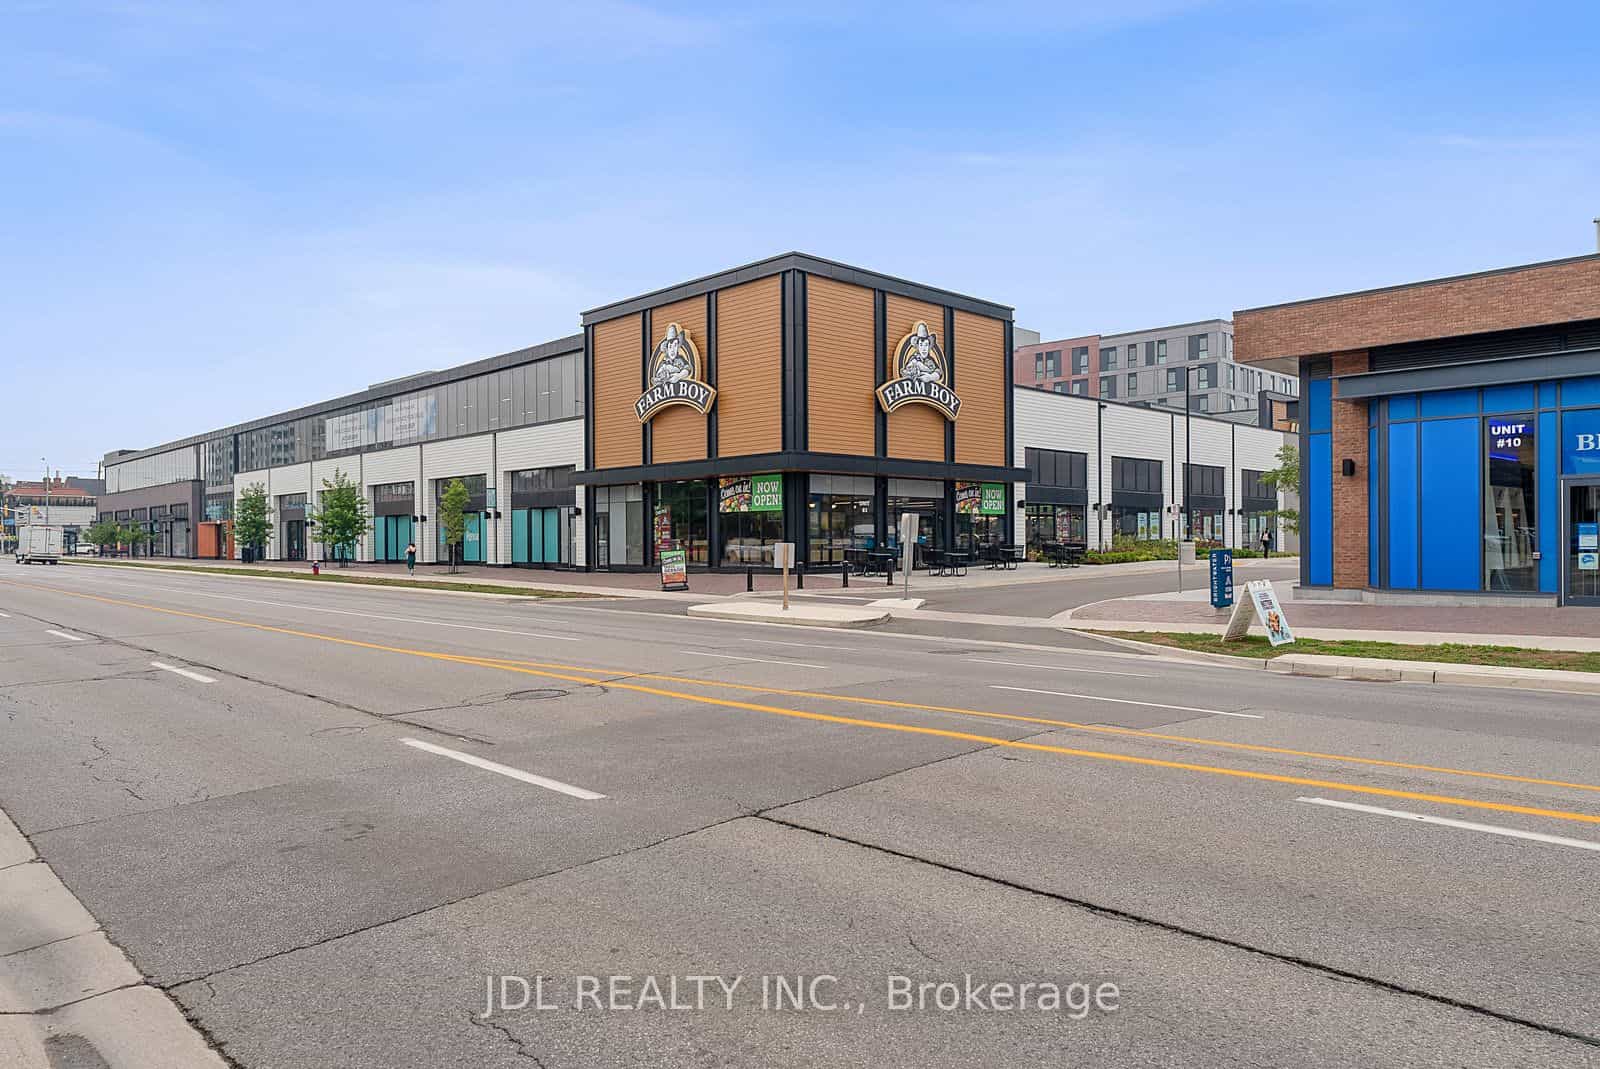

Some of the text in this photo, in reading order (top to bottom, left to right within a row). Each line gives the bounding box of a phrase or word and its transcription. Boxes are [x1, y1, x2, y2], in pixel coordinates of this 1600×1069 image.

[637, 381, 709, 416] FARM BOY
[884, 380, 959, 411] FARM BOY
[1491, 424, 1526, 436] UNIT
[1496, 437, 1522, 448] #10
[757, 481, 779, 494] NOW
[753, 494, 783, 506] OPEN!
[986, 489, 1002, 499] NOW
